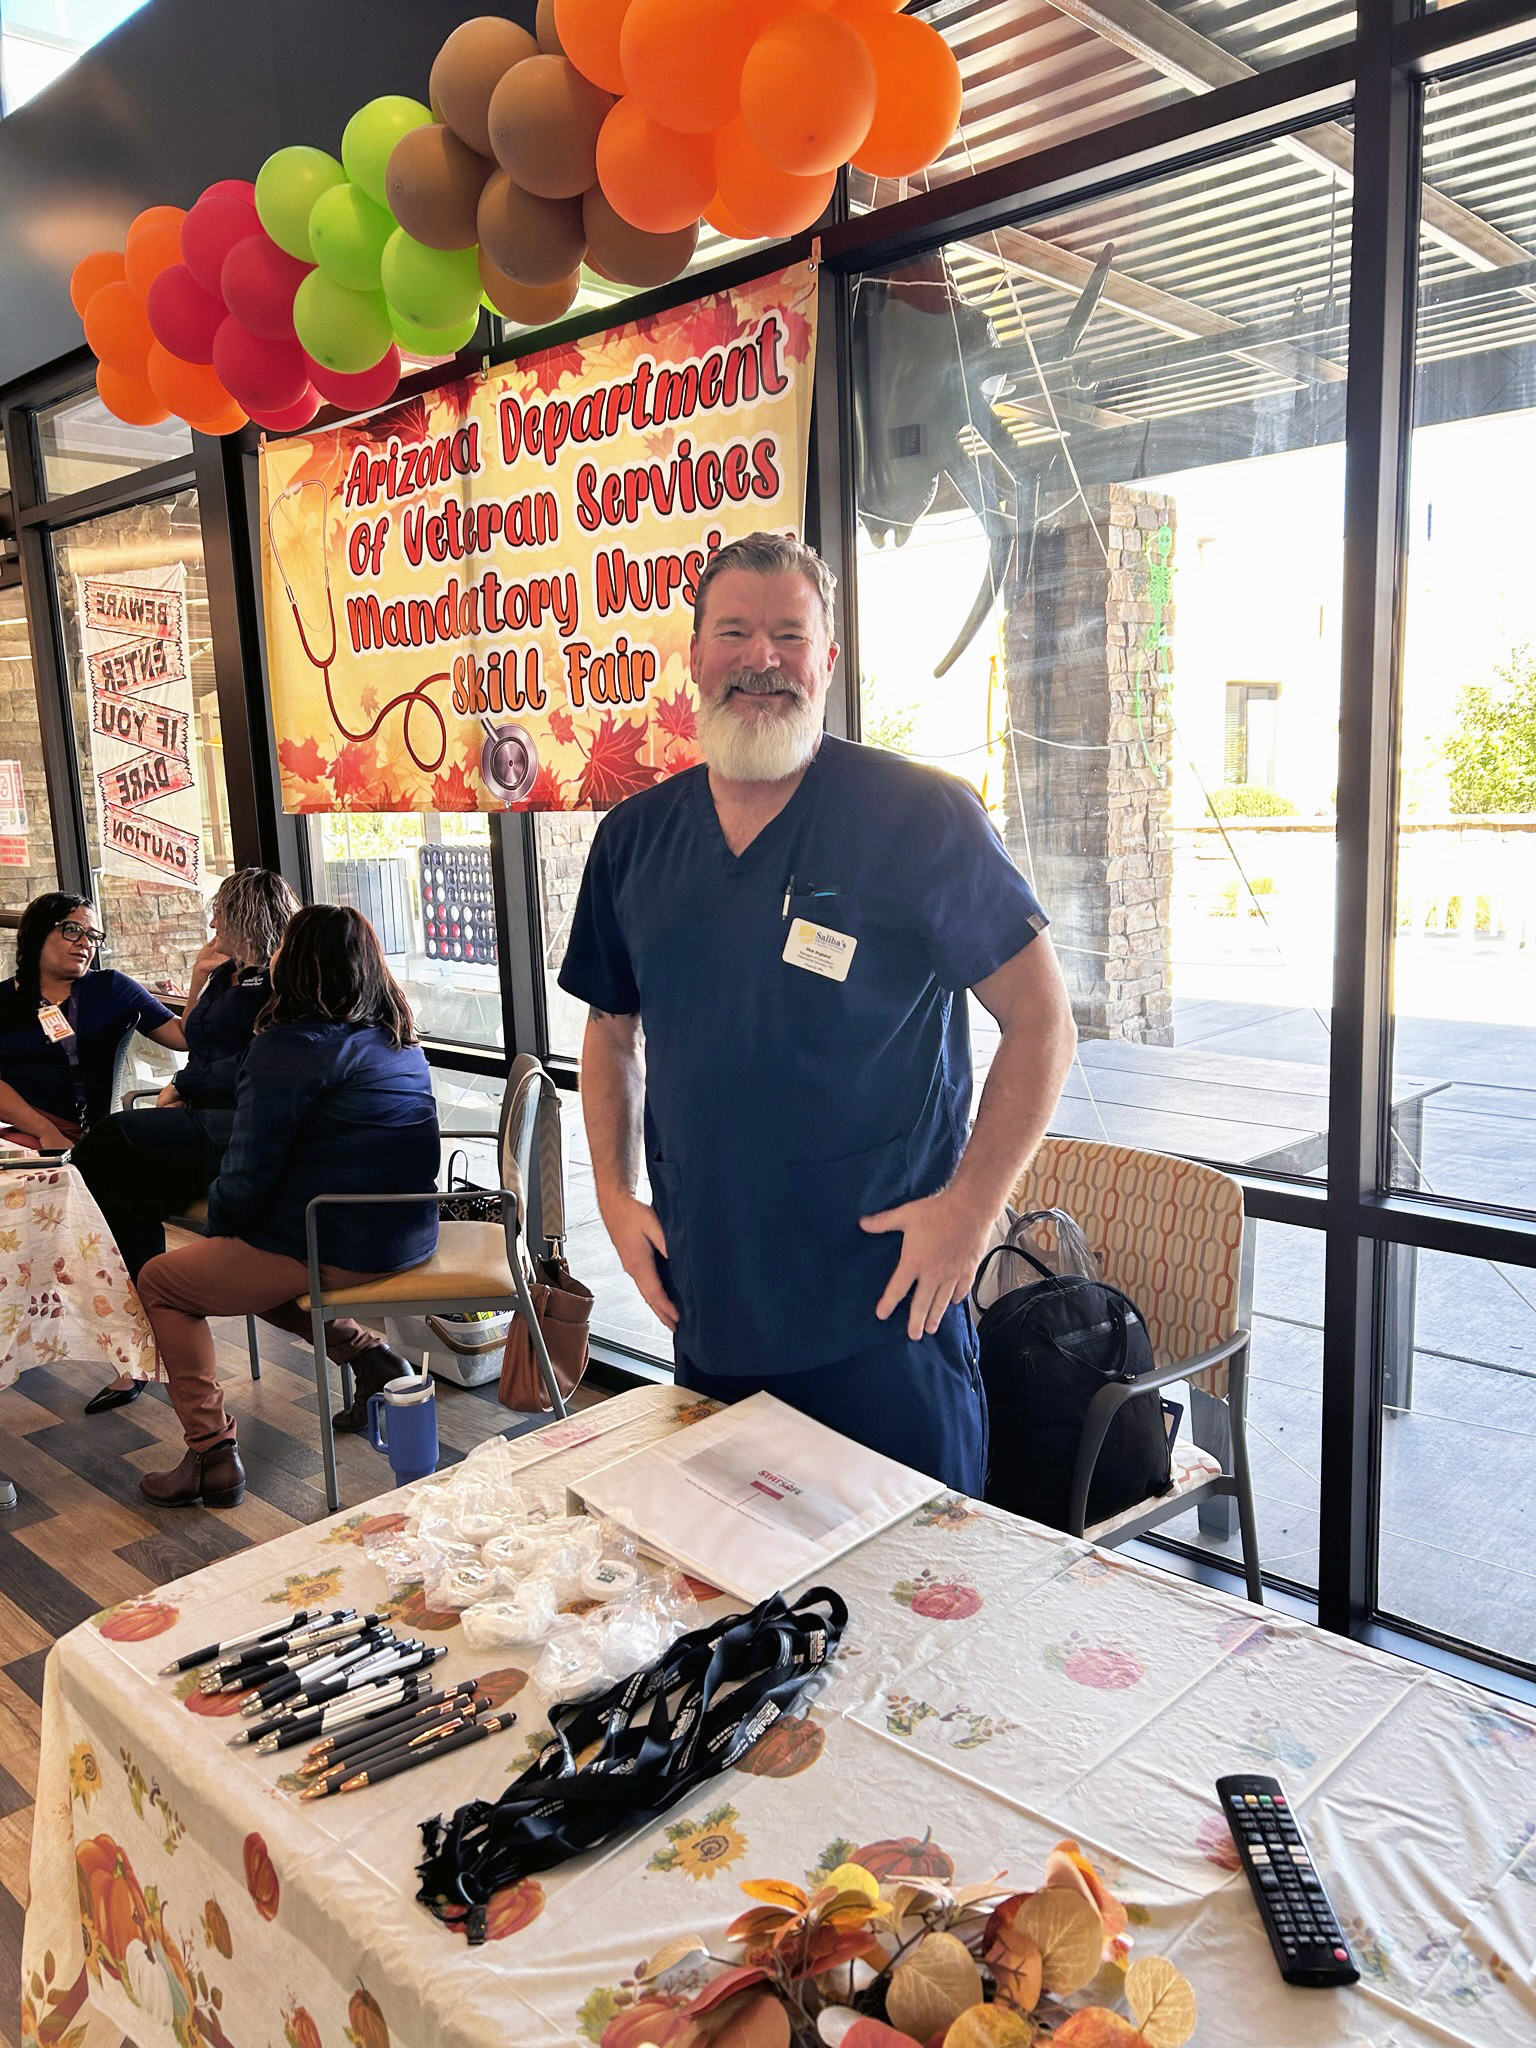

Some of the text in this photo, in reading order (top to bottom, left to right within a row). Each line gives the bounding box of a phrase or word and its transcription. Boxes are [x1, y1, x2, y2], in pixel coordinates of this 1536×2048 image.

[345, 316, 789, 506] Arizona Department
[403, 490, 559, 565] Veteran
[577, 438, 779, 530] Services
[347, 530, 721, 652] Mandatory Nurs
[452, 636, 657, 715] Skill Fair
